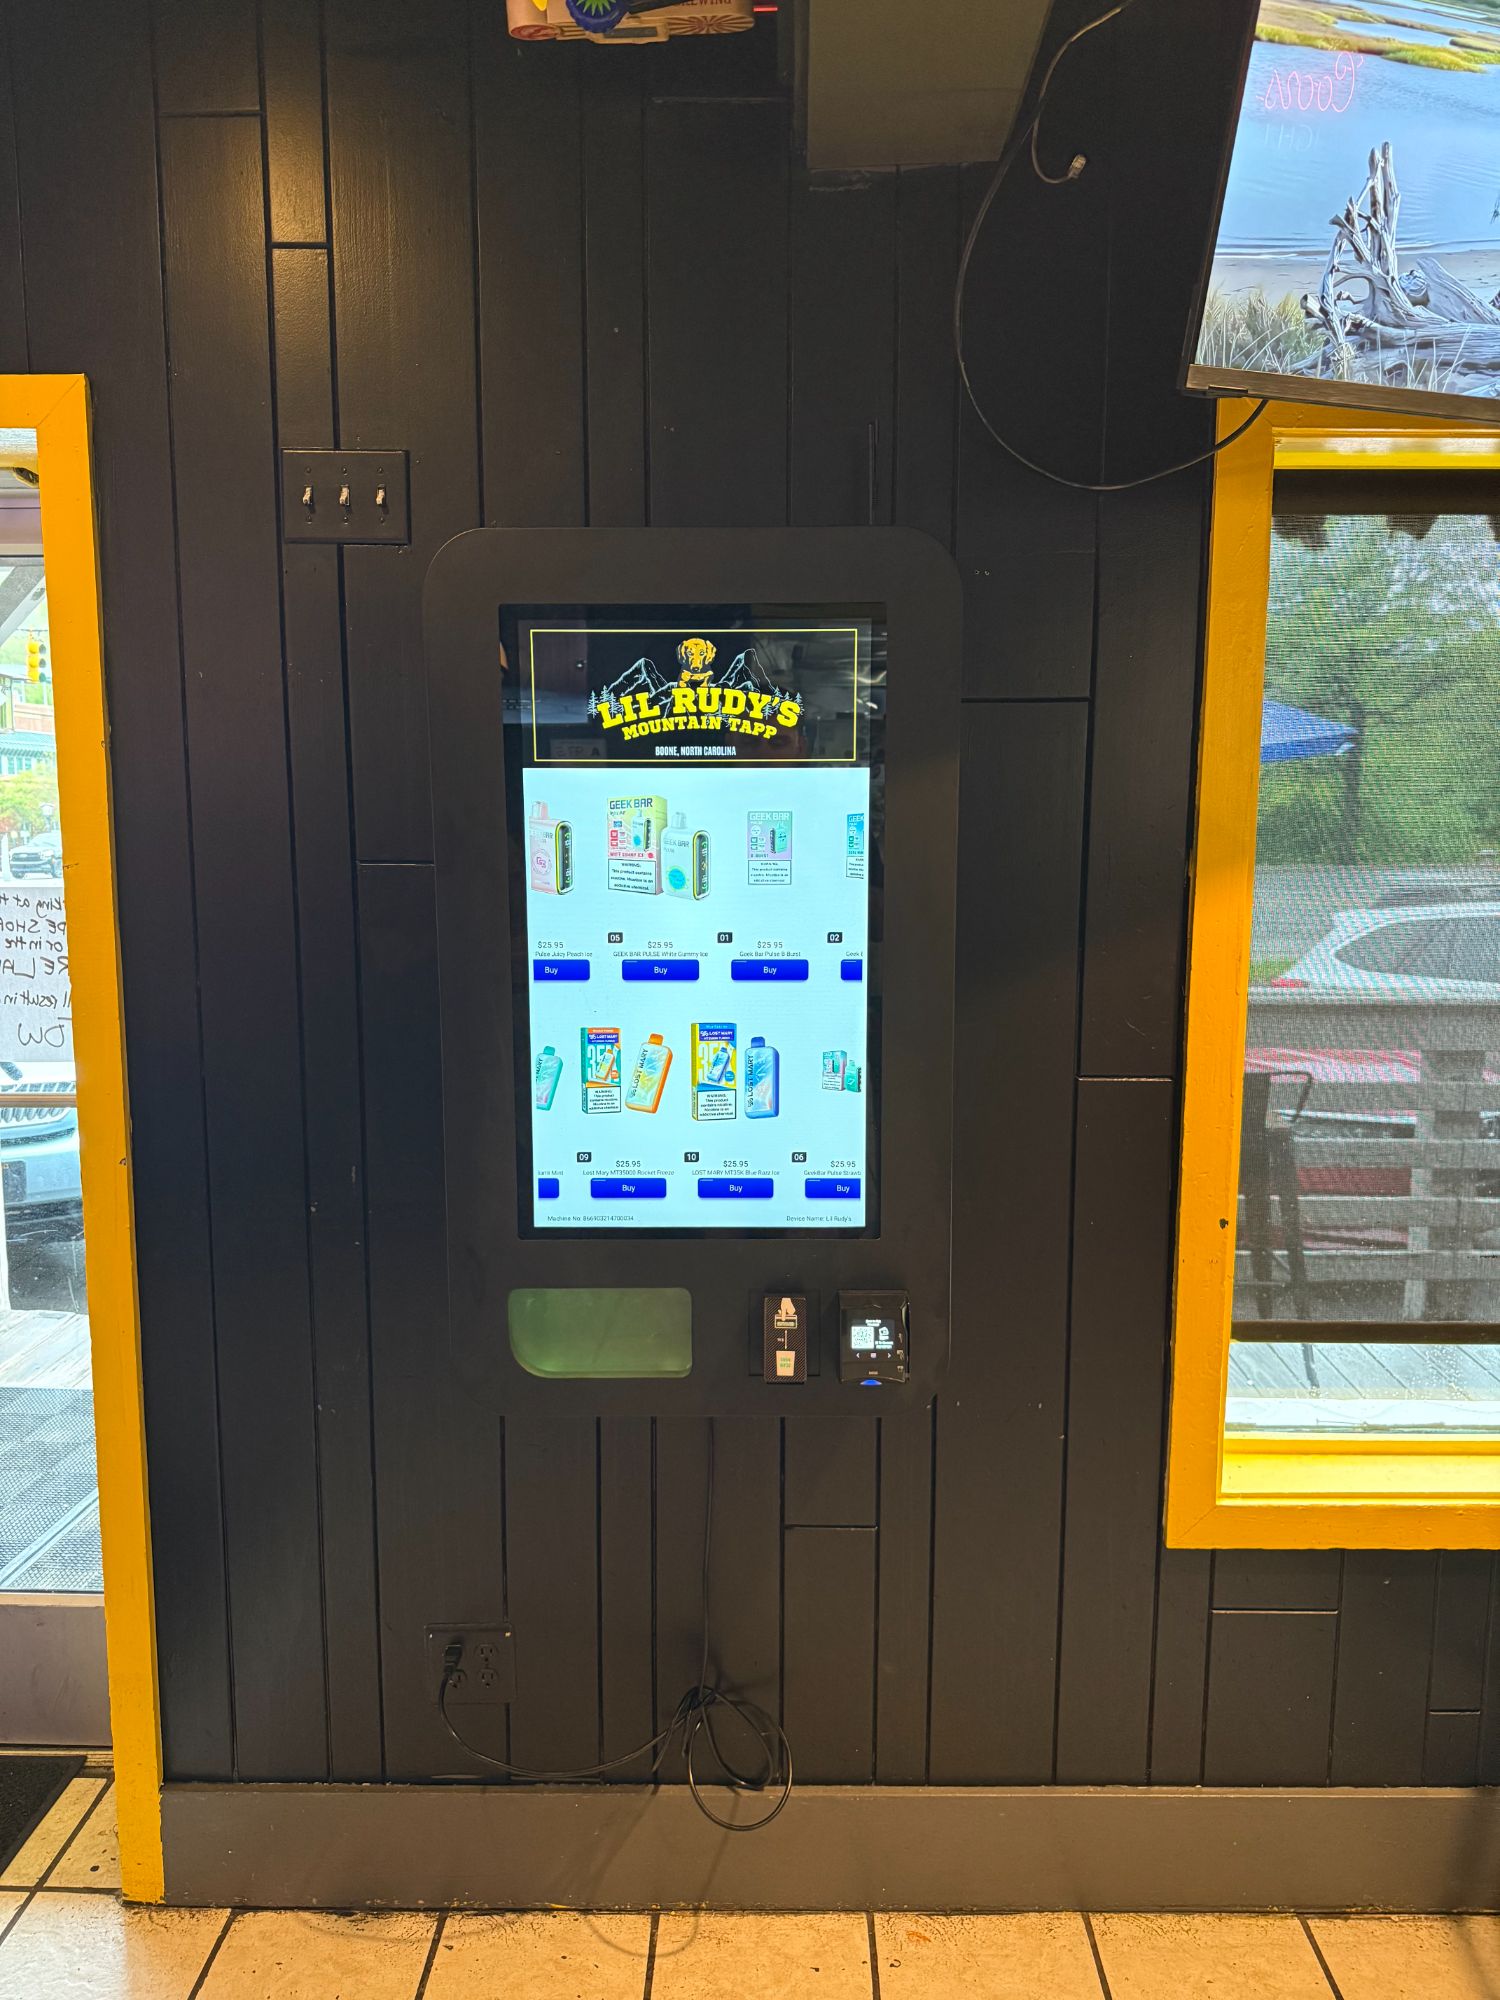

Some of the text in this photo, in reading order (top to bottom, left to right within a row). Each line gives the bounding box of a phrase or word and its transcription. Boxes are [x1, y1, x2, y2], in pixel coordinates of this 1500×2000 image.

[597, 687, 801, 729] LIL RUDY'S
[622, 716, 778, 741] MOUNTAIN TAPP
[655, 746, 737, 757] BOONE, NORTH CAROLINA
[610, 798, 653, 810] GEEK BAR
[750, 812, 790, 821] GEEK BAR
[610, 934, 621, 942] 05
[720, 934, 730, 942] 01
[830, 934, 840, 942] 02
[538, 941, 564, 949] $25.95
[648, 941, 674, 949] $25.95
[757, 941, 783, 949] $25.95
[544, 966, 558, 975] Buy
[653, 966, 668, 975] Buy
[763, 966, 777, 975] Buy
[632, 1048, 648, 1089] LOST MARY
[579, 1153, 589, 1161] 09
[687, 1153, 697, 1161] 10
[794, 1153, 804, 1161] 06
[615, 1160, 641, 1168] $25.95
[723, 1160, 749, 1168] $25.95
[830, 1160, 856, 1168] $25.95
[596, 1169, 609, 1177] Mary
[622, 1184, 636, 1193] Buy
[729, 1184, 743, 1193] Buy
[836, 1184, 850, 1194] Buy
